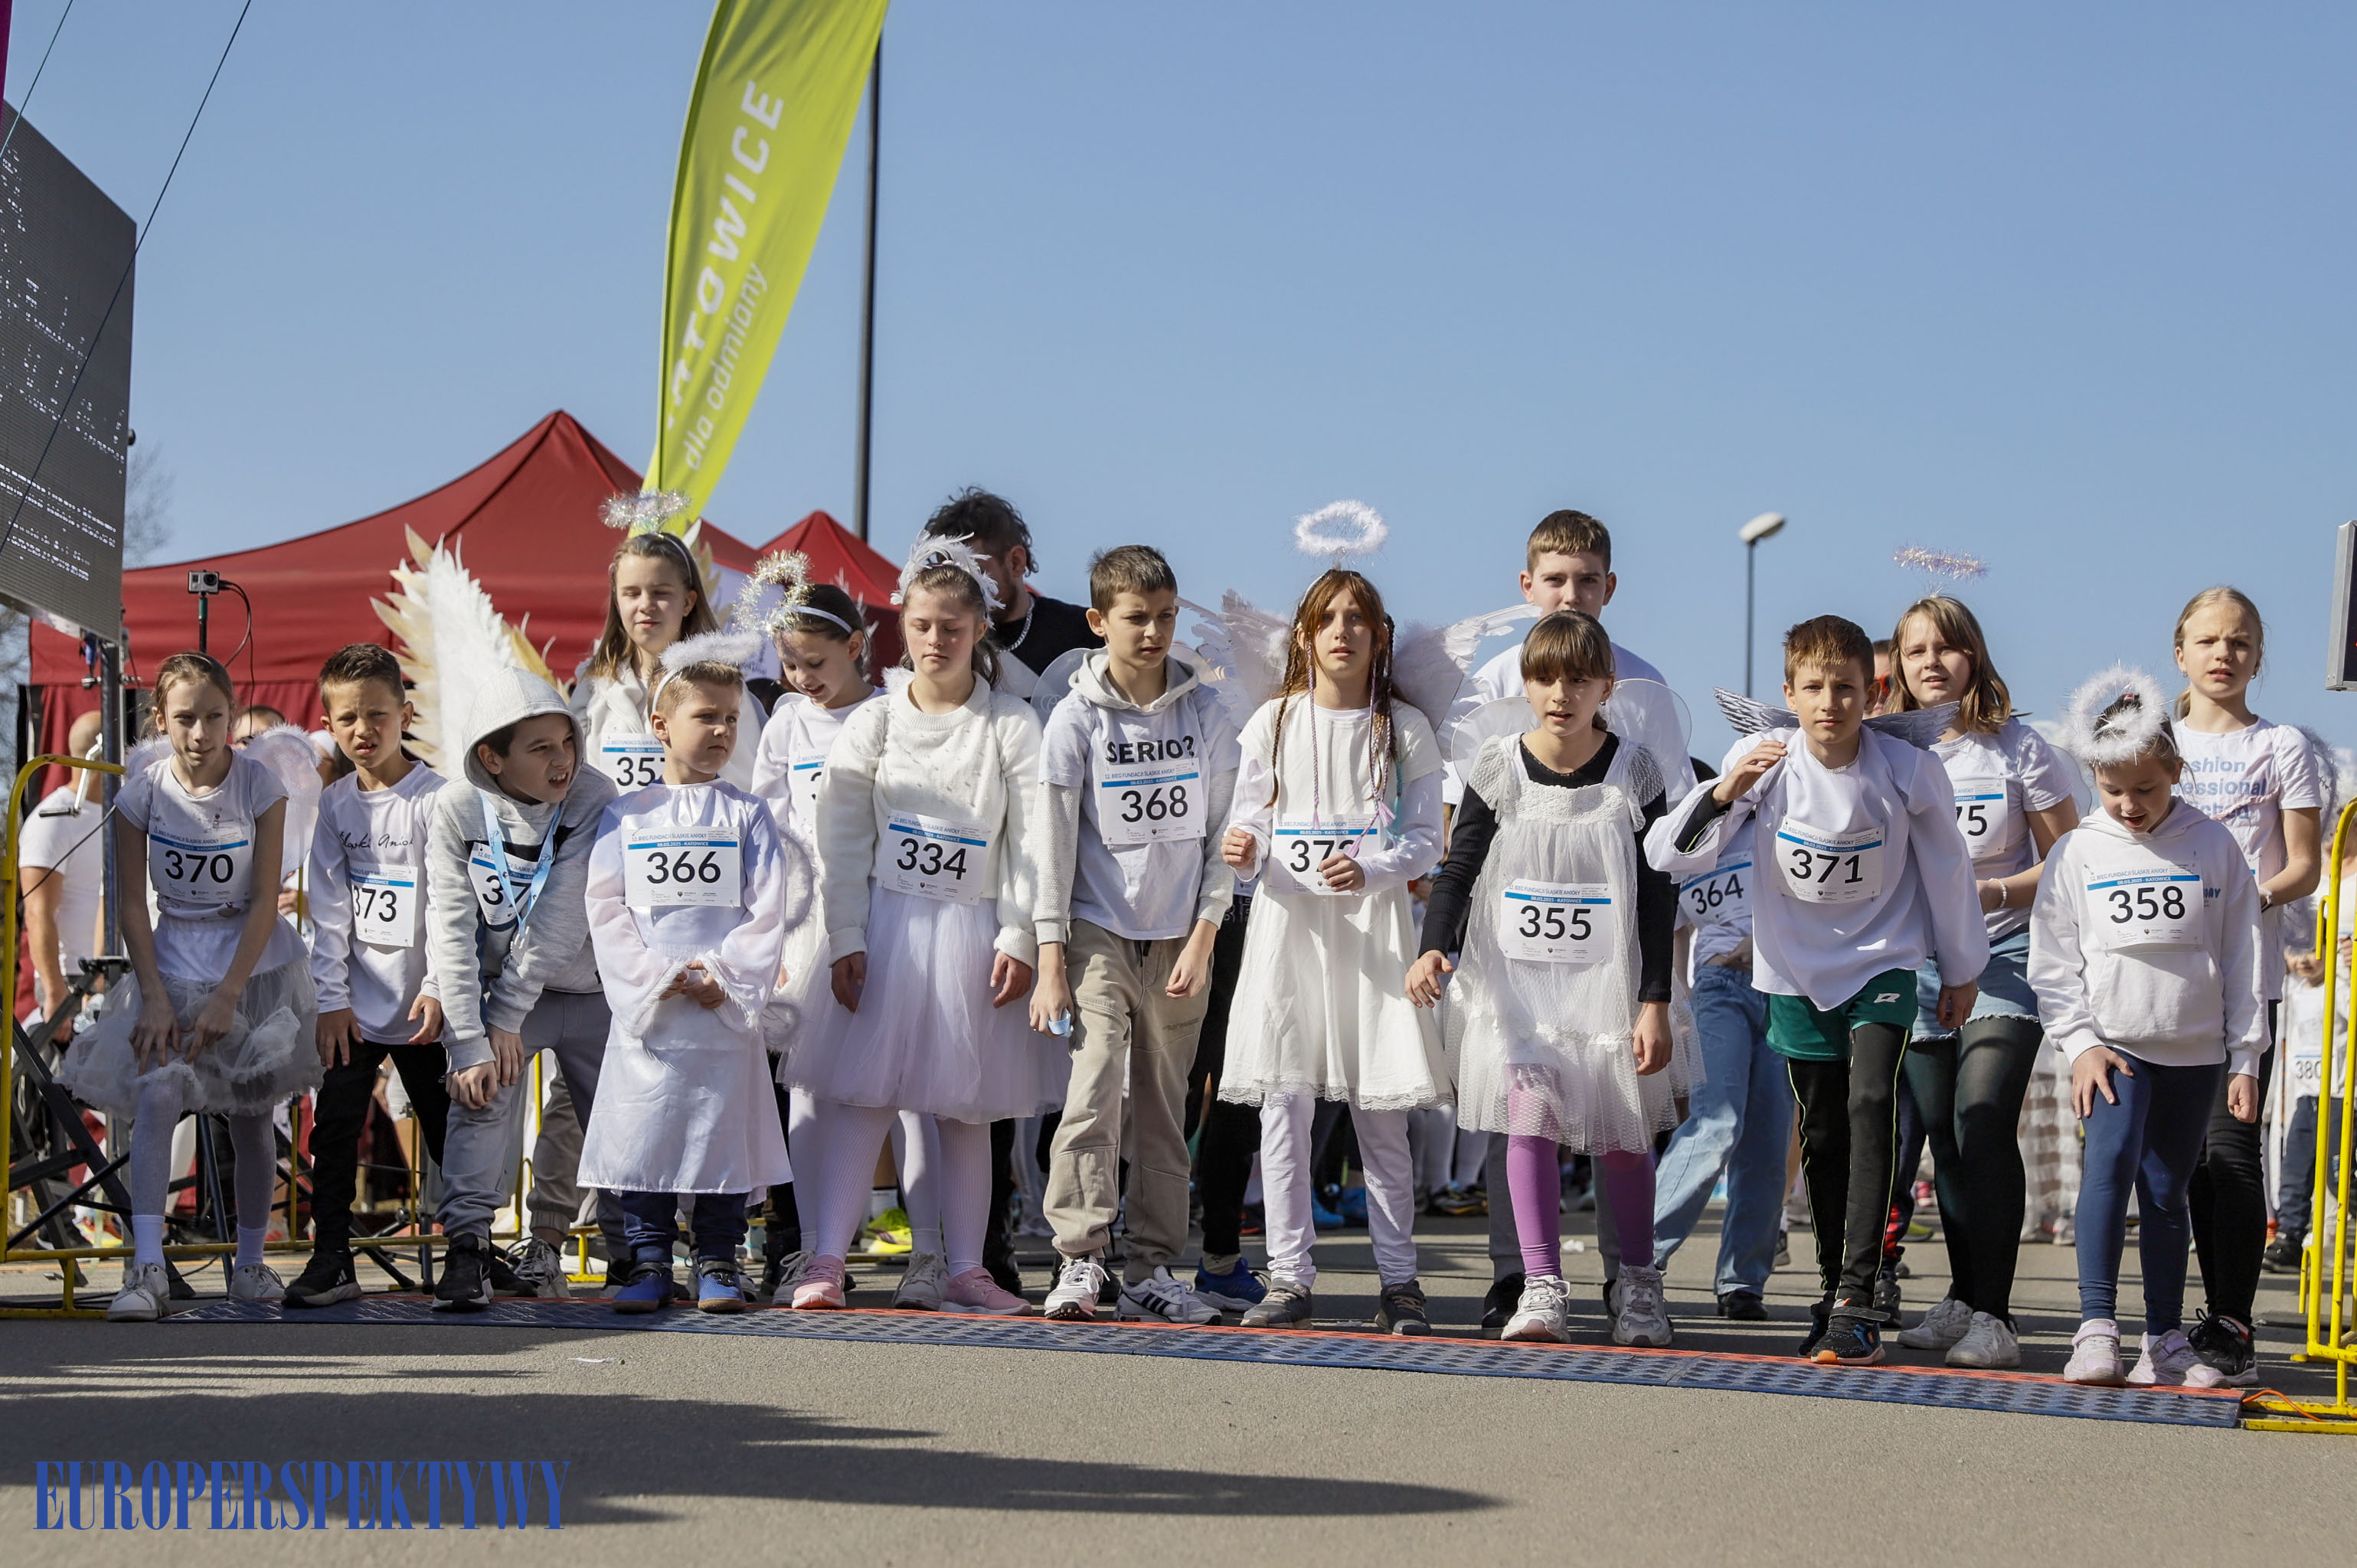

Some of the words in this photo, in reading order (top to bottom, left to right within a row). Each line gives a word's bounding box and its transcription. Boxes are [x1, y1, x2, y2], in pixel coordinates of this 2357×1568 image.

[668, 80, 784, 430] ATOWICE
[685, 415, 714, 471] dla
[707, 261, 769, 413] odmiany
[1105, 735, 1195, 764] SERIO?
[2183, 756, 2246, 773] shion
[616, 756, 665, 786] 35
[1121, 785, 1188, 822] 368
[1956, 805, 1987, 836] 5
[165, 850, 234, 884] 370
[646, 851, 721, 884] 366
[897, 838, 966, 880] 334
[1790, 848, 1863, 884] 371
[353, 885, 397, 922] 373
[482, 874, 532, 908] 37
[1691, 873, 1744, 914] 364
[2108, 885, 2185, 923] 358
[1518, 905, 1591, 941] 355
